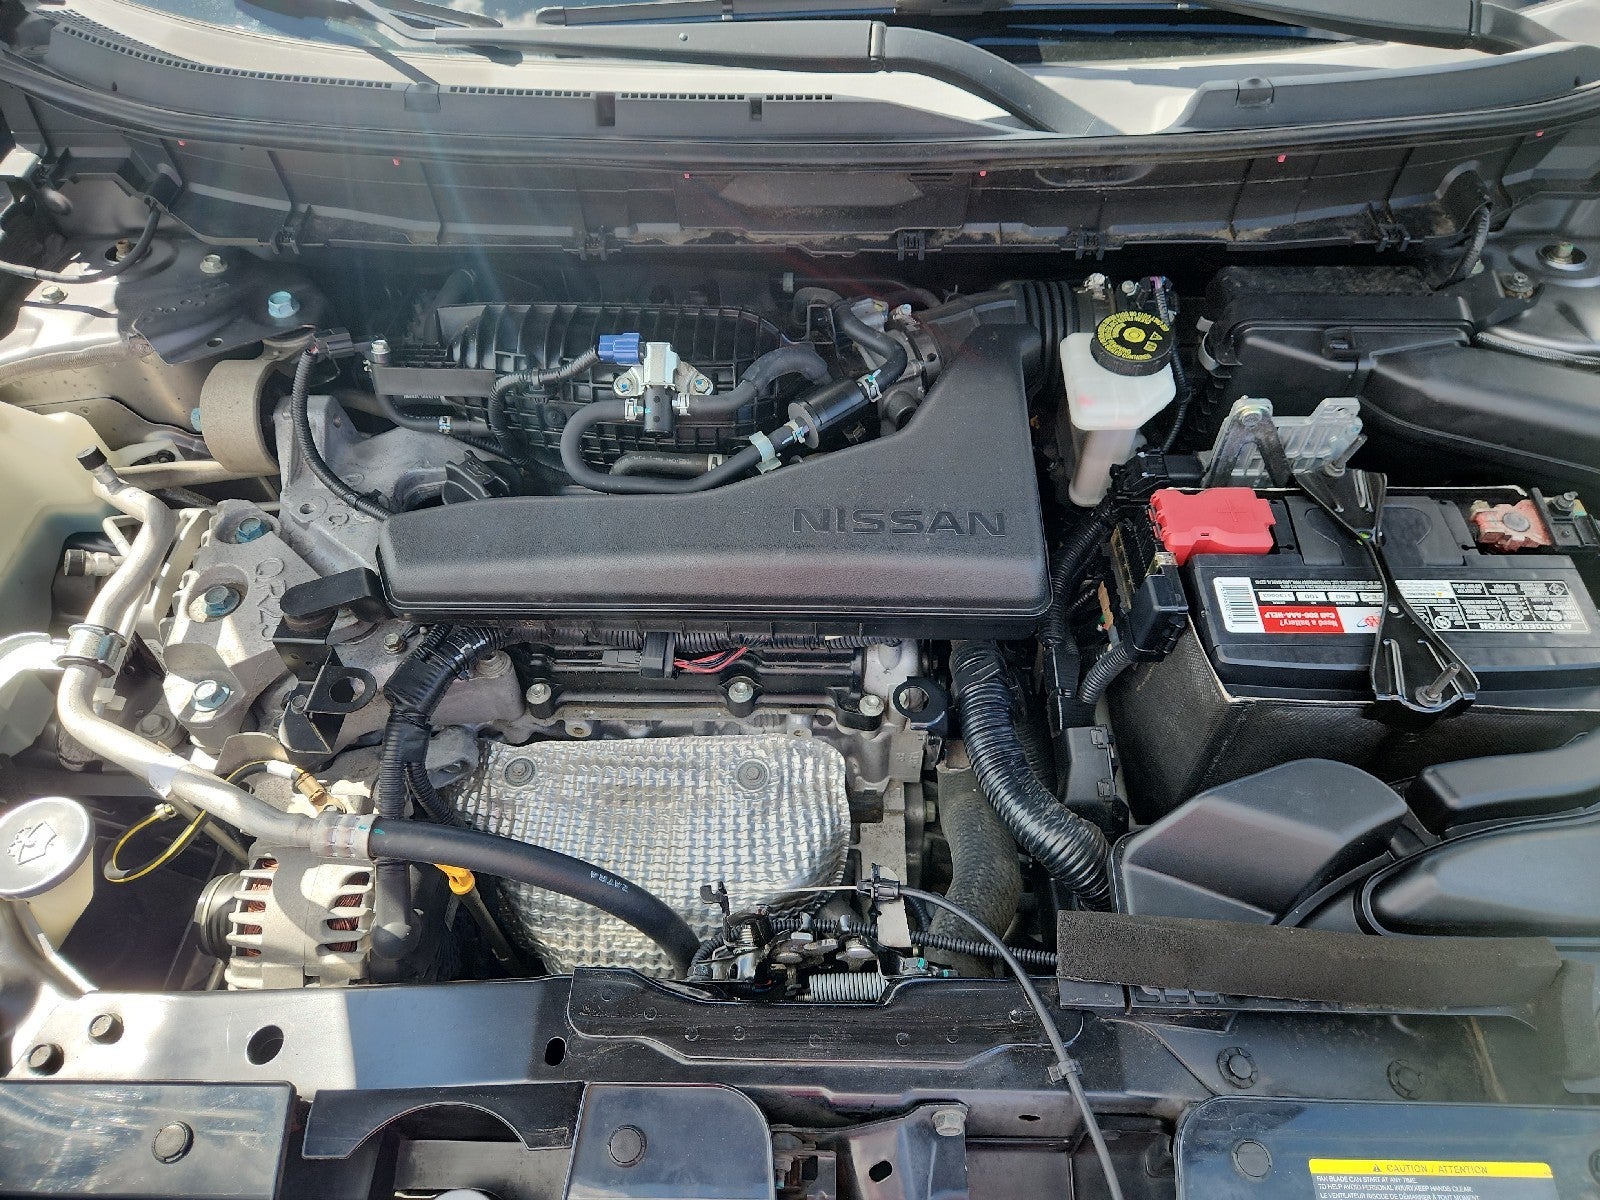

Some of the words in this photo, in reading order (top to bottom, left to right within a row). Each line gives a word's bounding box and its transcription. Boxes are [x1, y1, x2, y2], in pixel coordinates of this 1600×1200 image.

[792, 507, 1006, 537] NISSAN
[1279, 618, 1310, 627] battery?
[1318, 619, 1338, 627] Need
[1386, 1164, 1428, 1173] CAUTION
[1438, 1165, 1488, 1174] ATTENTION
